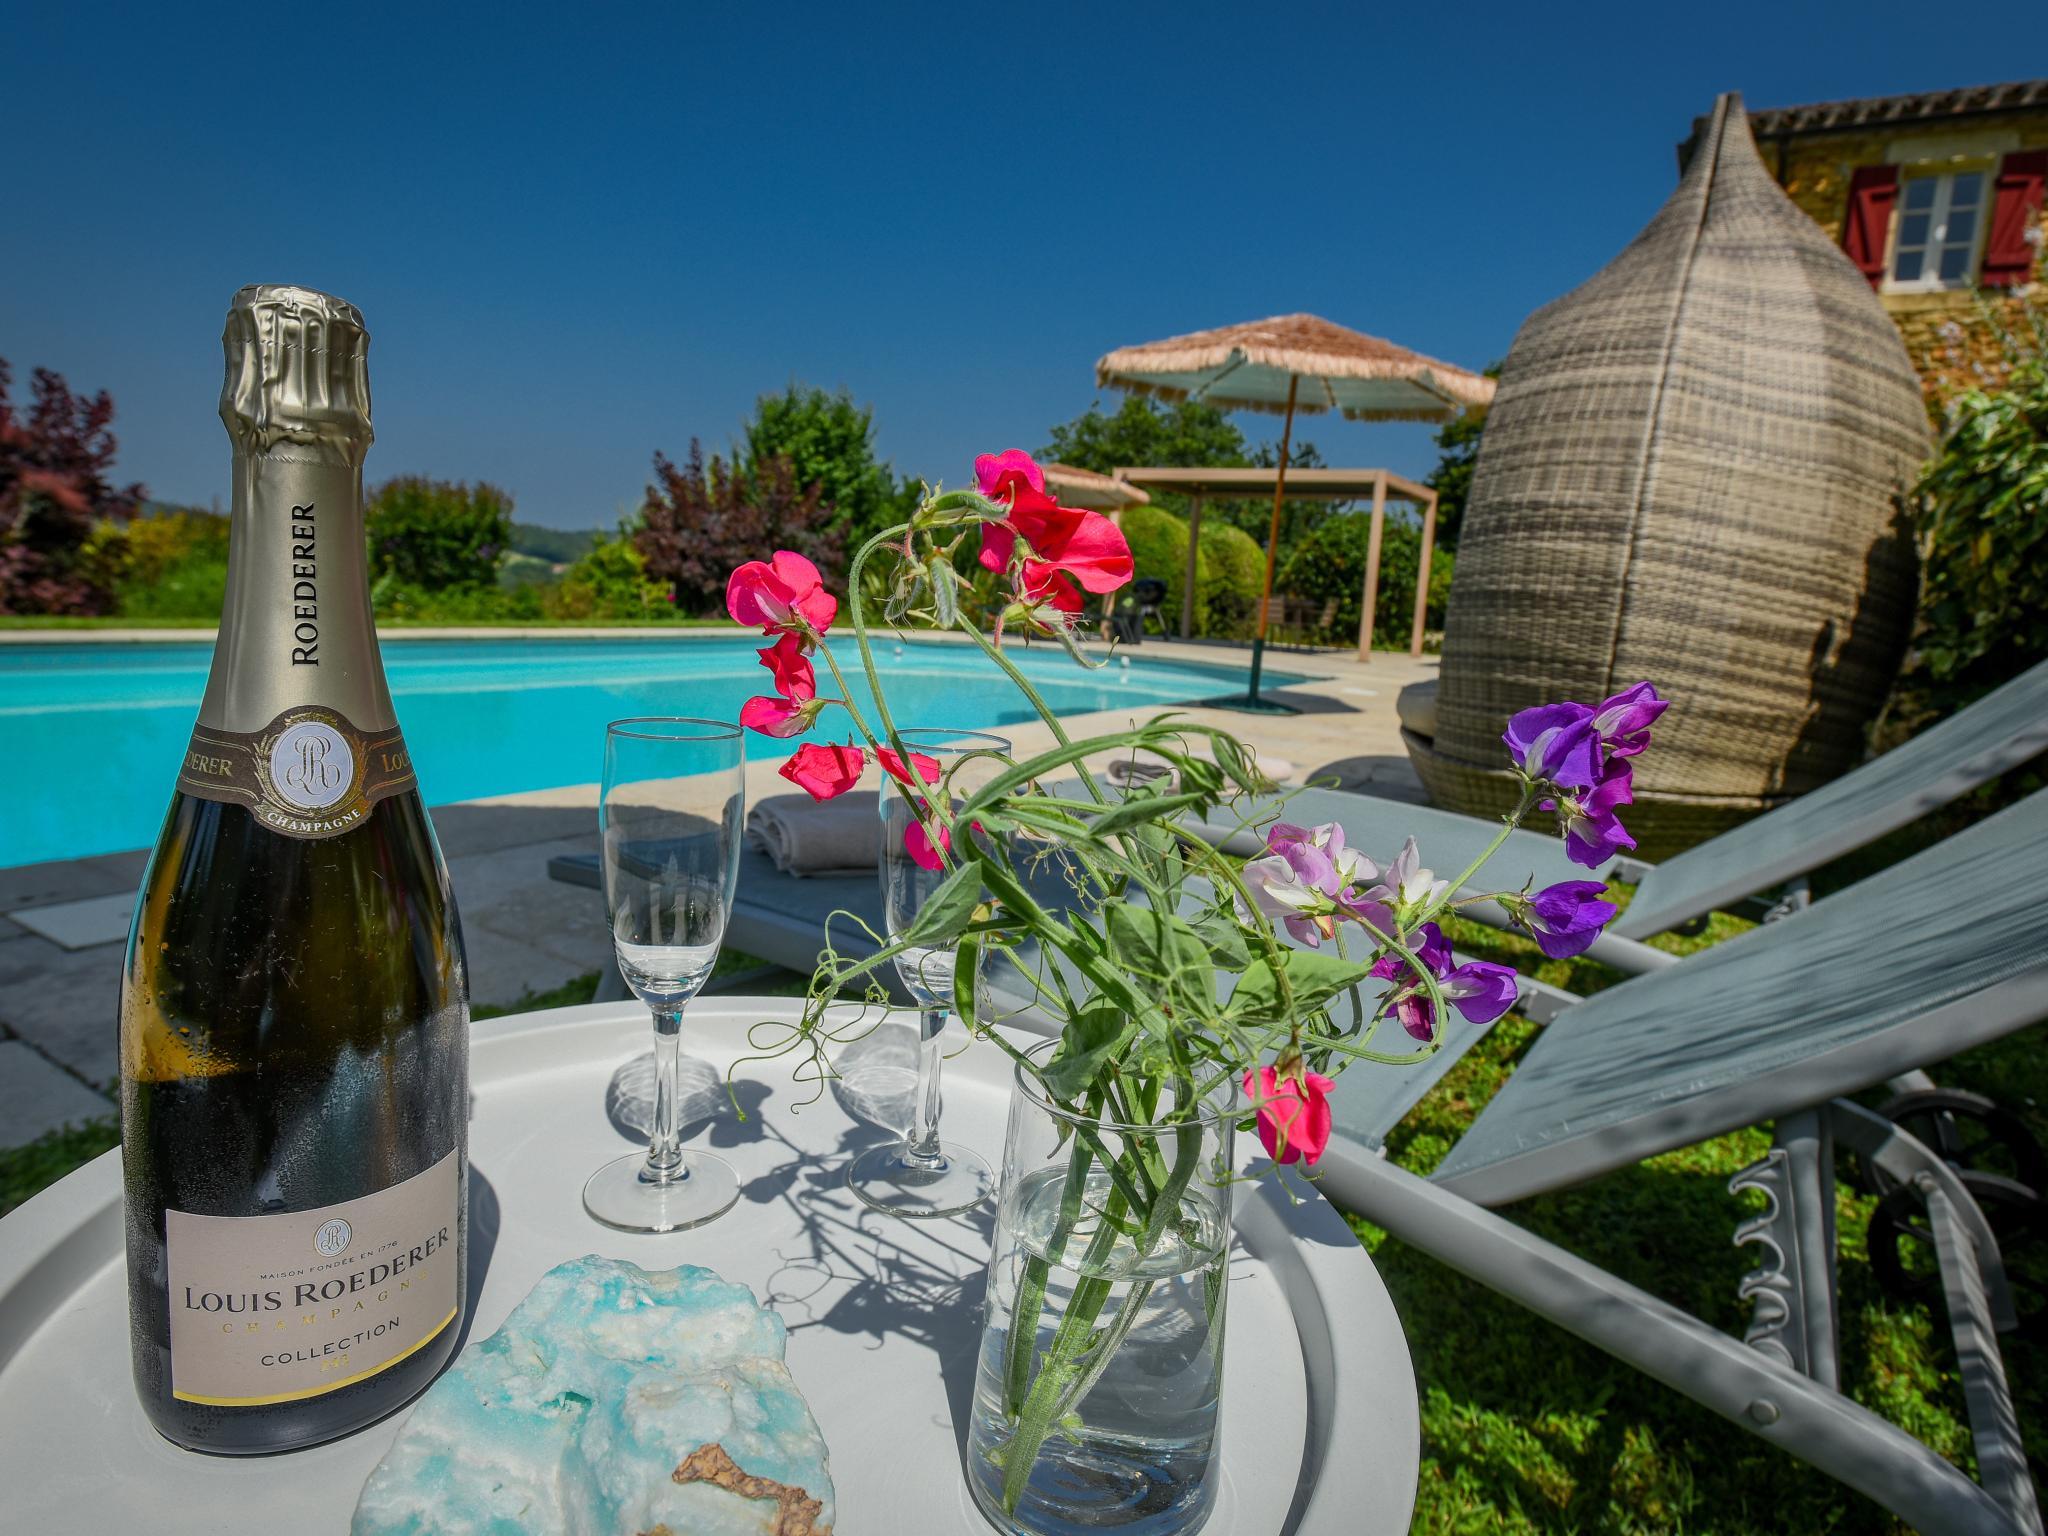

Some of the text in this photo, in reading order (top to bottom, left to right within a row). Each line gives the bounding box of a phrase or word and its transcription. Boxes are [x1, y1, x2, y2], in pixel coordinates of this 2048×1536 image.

[291, 502, 319, 666] ROEDERER
[266, 808, 361, 832] CHAMPAGNE
[185, 1226, 449, 1313] LOUIS ROEDERER
[259, 1269, 305, 1281] MAISON
[360, 1250, 374, 1260] EN
[378, 1240, 399, 1253] 1776
[260, 1316, 400, 1367] COLLECTION
